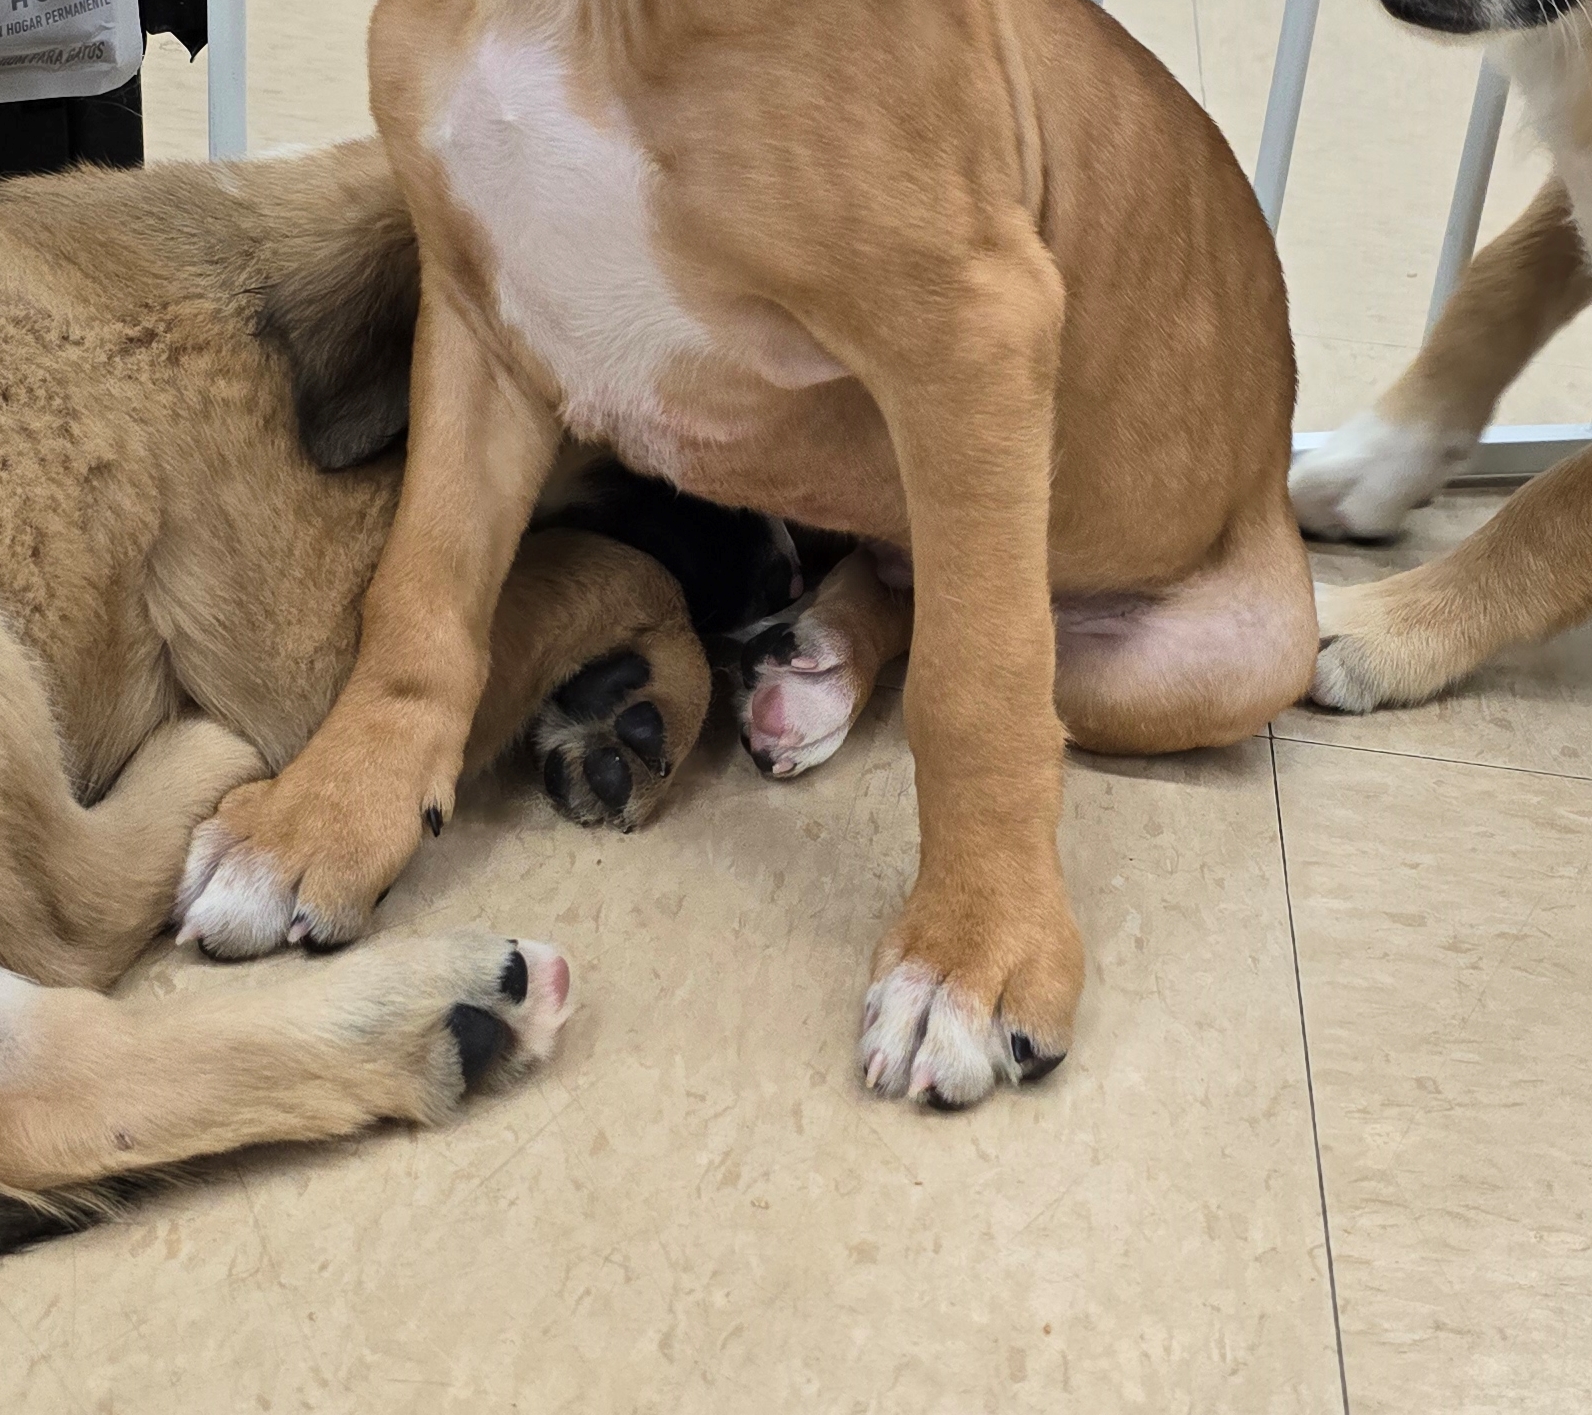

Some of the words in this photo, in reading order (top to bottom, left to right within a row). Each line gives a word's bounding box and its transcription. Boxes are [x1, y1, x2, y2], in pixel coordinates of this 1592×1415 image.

[6, 15, 43, 36] HOGAR
[28, 49, 63, 66] PARA
[65, 41, 105, 63] GATOS
